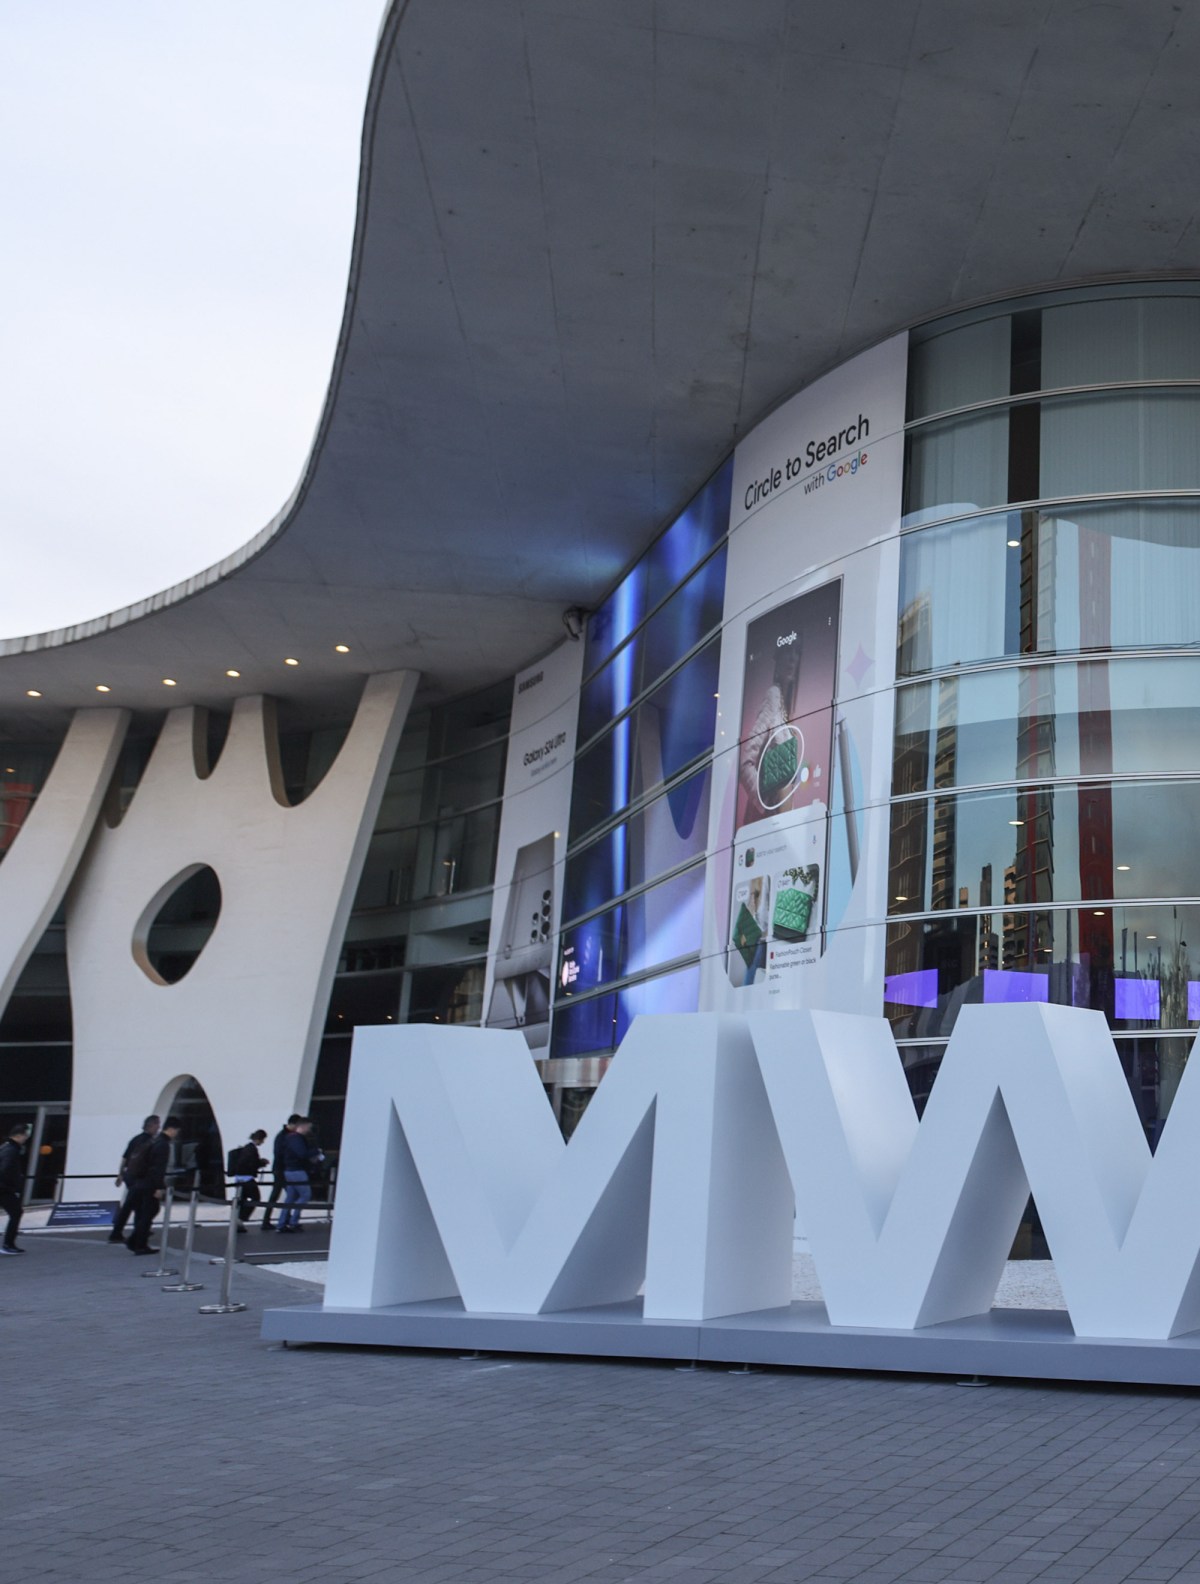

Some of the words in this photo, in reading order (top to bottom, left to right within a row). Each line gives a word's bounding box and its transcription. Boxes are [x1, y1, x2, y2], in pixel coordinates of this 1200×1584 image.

[744, 467, 782, 511] Circle
[785, 457, 802, 481] to
[805, 413, 870, 468] Search
[803, 472, 825, 495] with
[826, 451, 868, 482] Google
[776, 630, 798, 648] Google
